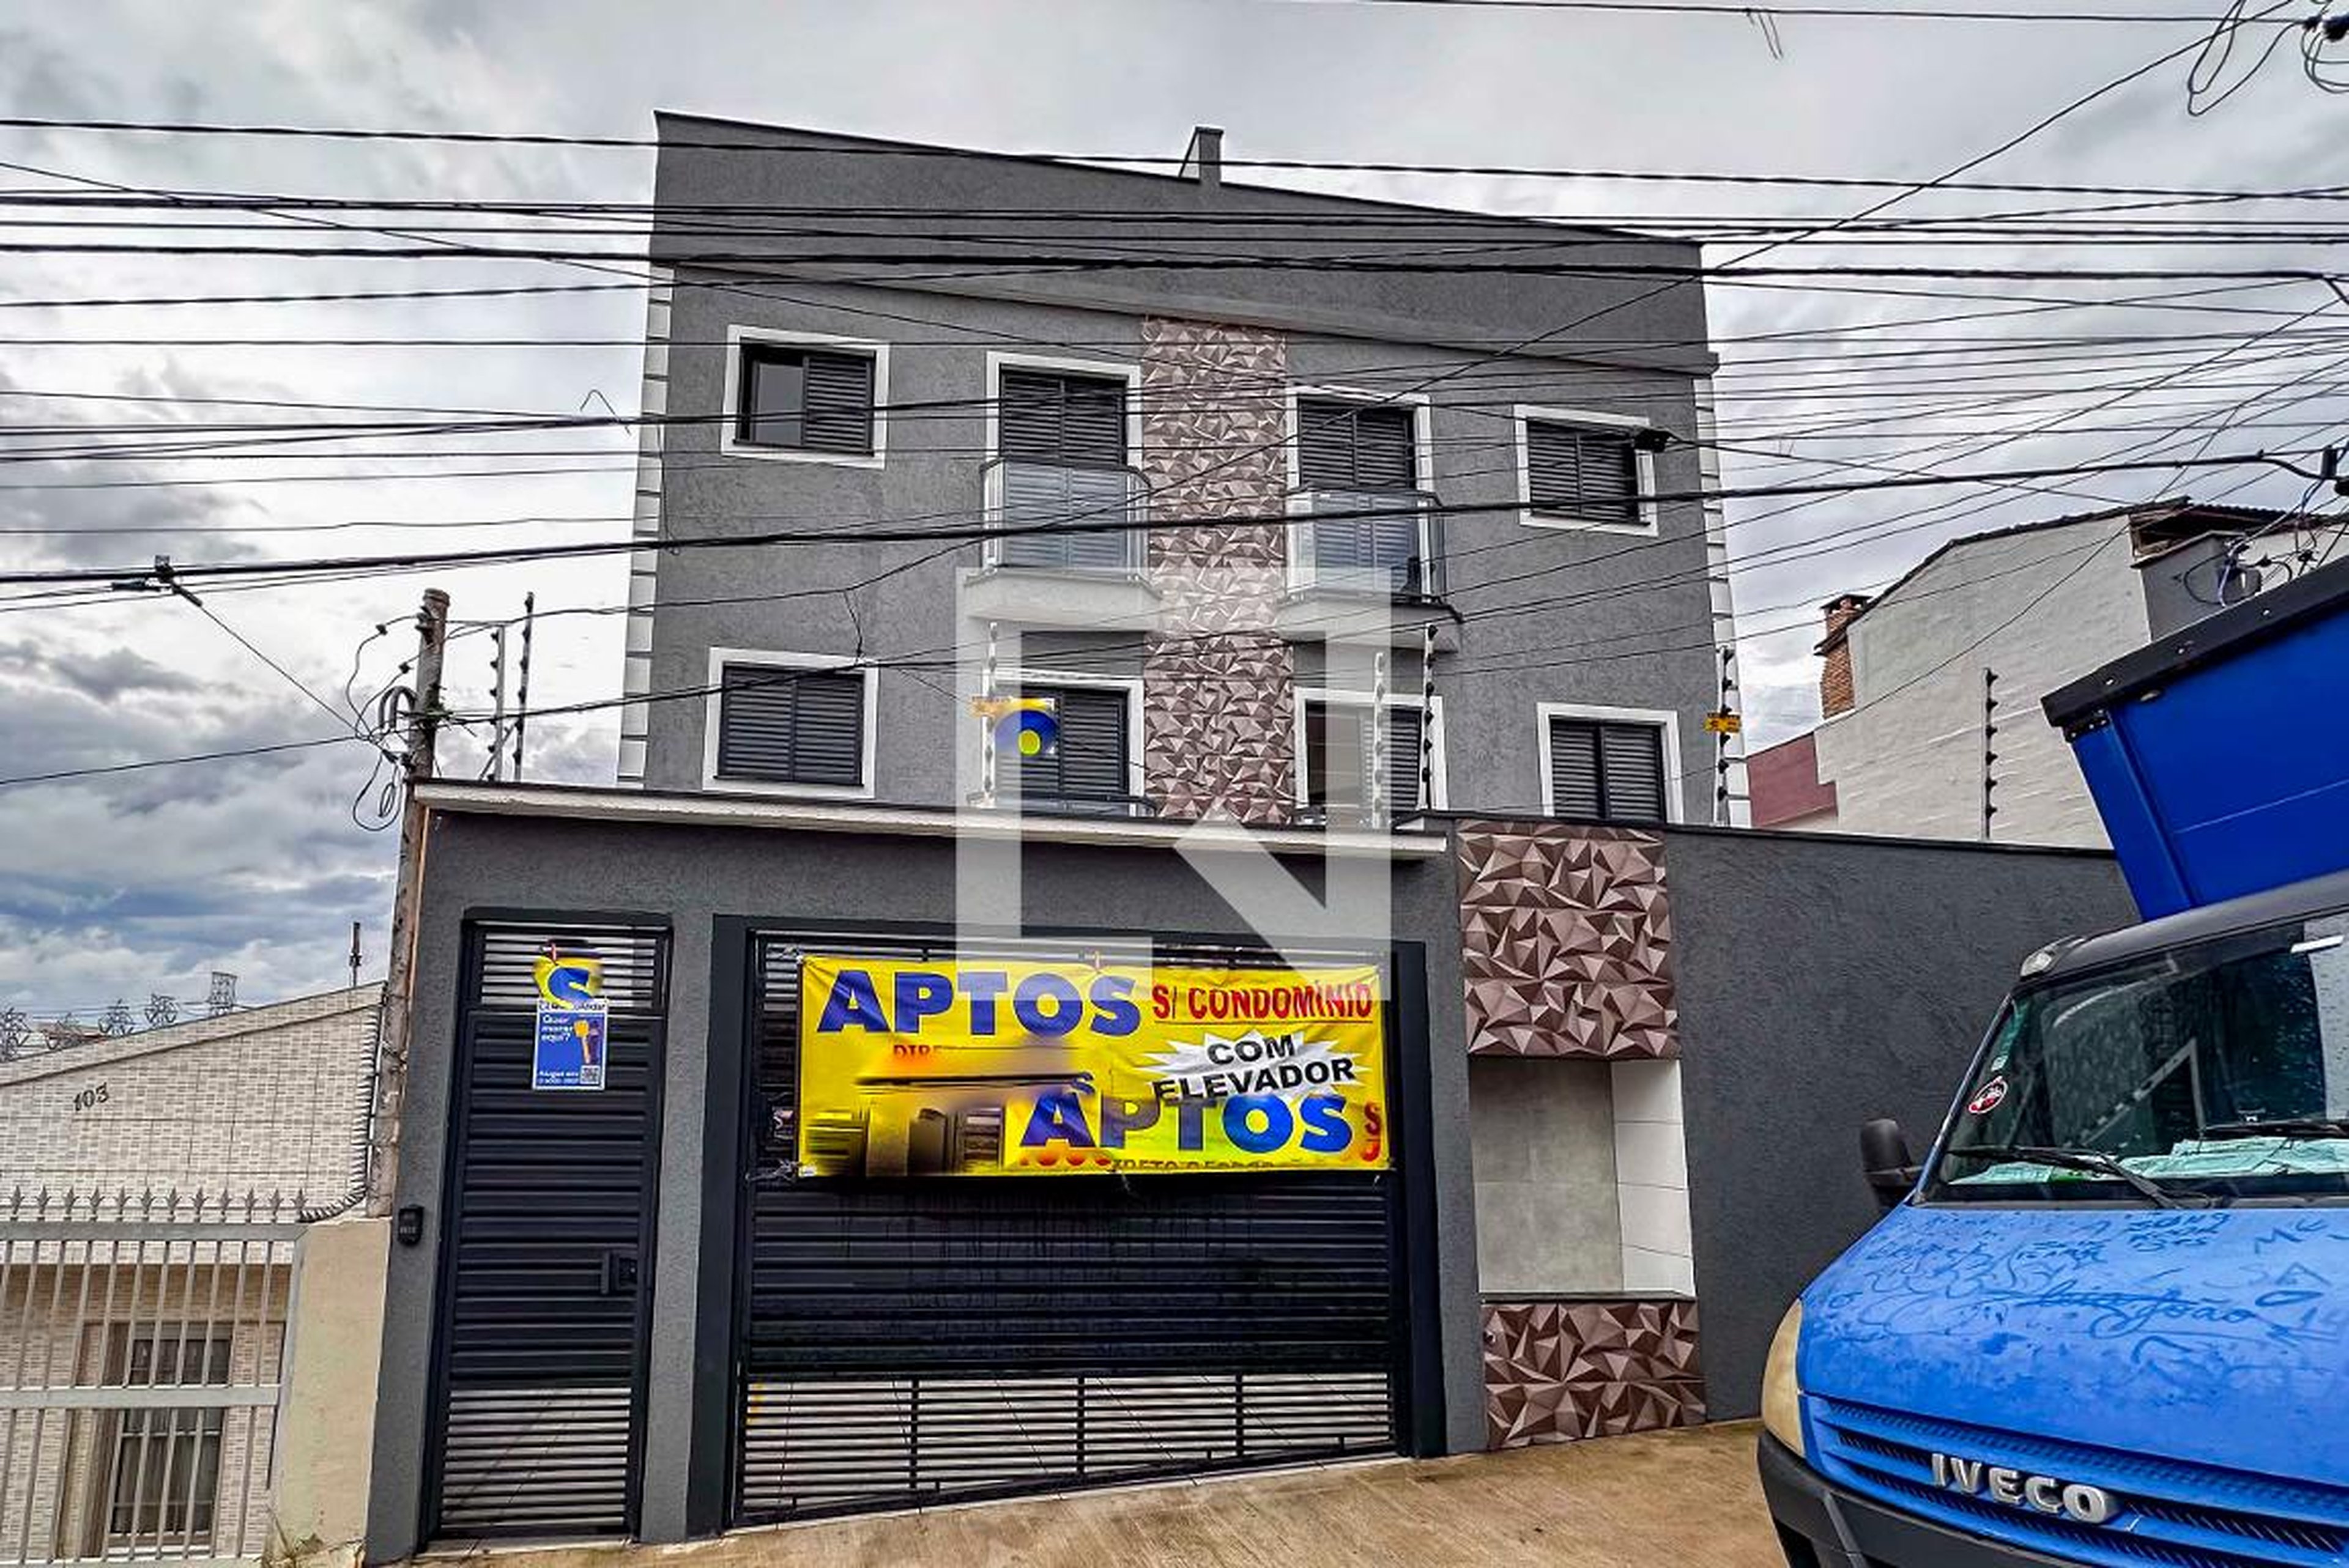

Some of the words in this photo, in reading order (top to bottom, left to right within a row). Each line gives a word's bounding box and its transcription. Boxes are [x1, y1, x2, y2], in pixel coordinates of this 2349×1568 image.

[817, 970, 1141, 1037] APTOS
[1152, 985, 1176, 1019] S/
[1208, 1034, 1296, 1065] COM
[73, 1082, 109, 1111] 103
[1153, 1057, 1356, 1101] ELEVADOR
[1020, 1093, 1353, 1153] APTOS
[1931, 1452, 2109, 1524] IVECO
